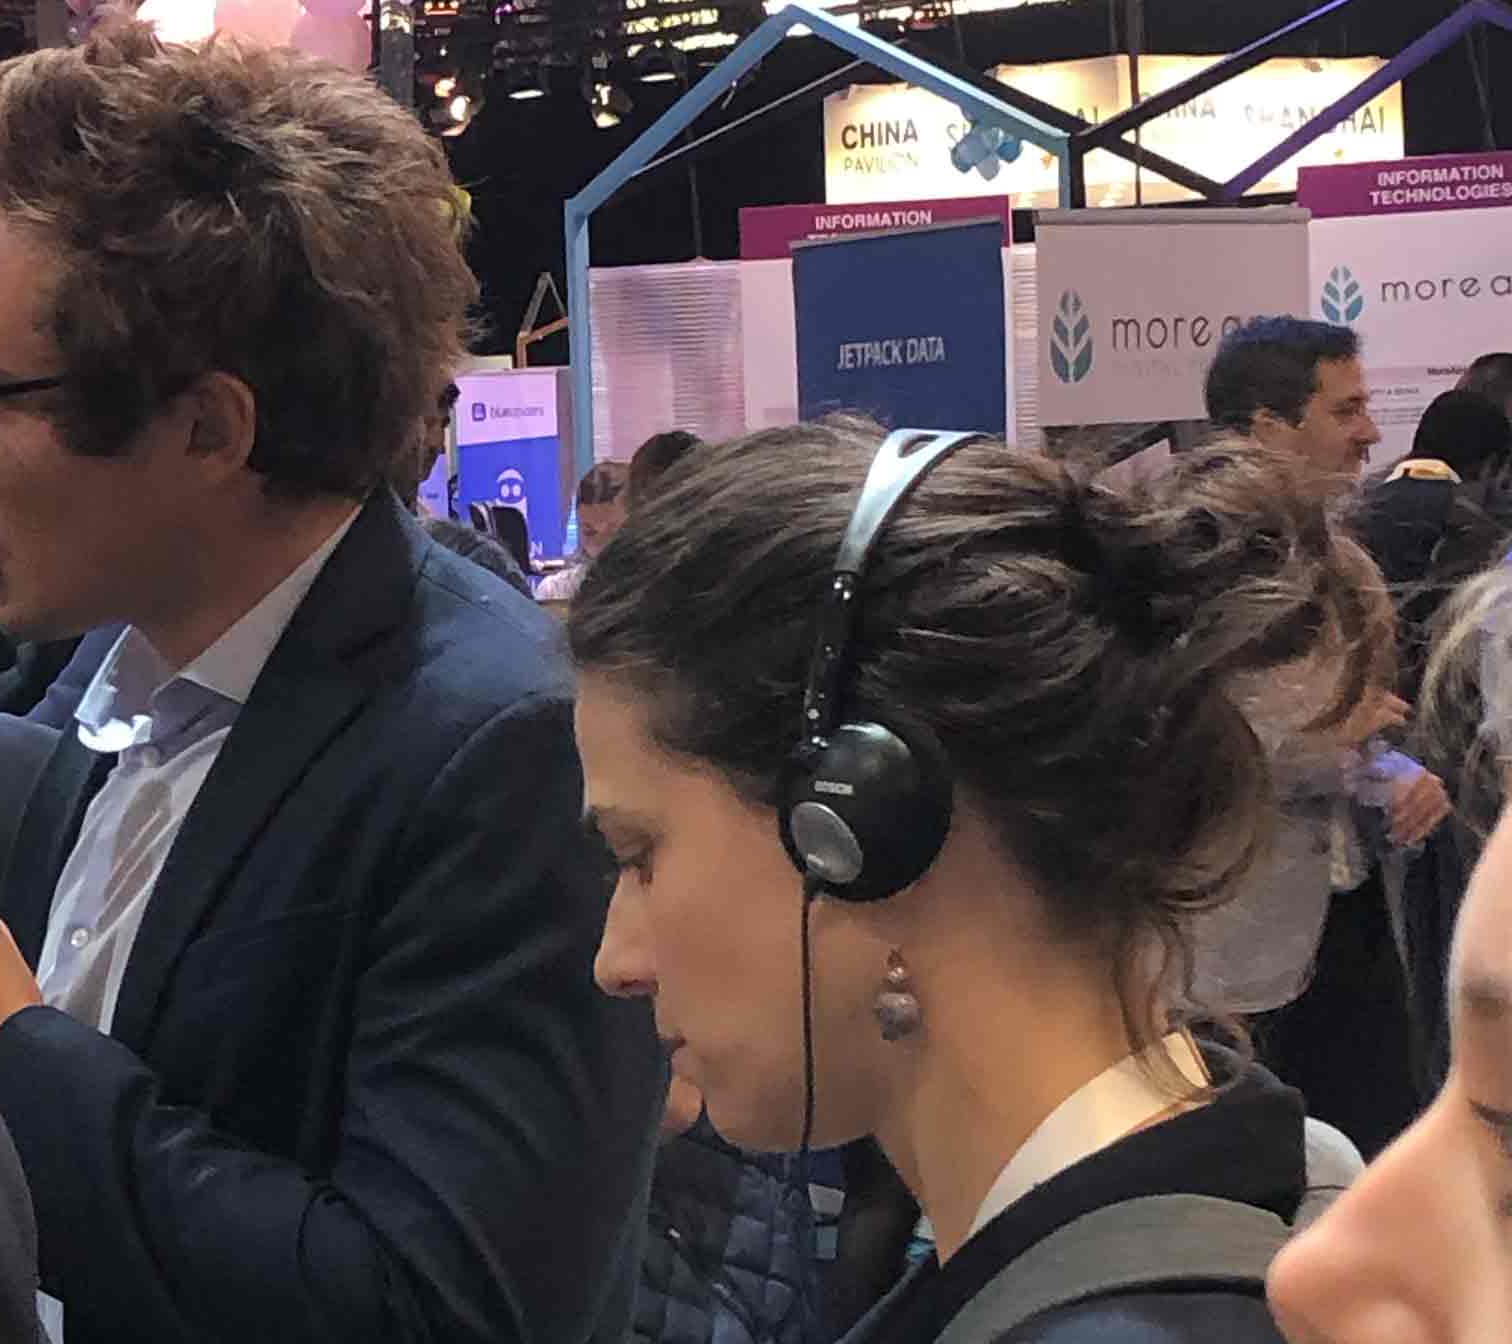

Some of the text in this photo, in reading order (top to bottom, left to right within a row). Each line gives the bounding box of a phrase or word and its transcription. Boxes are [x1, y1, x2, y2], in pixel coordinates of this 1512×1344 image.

[841, 118, 919, 150] CHINA
[1378, 164, 1504, 187] INFORMATION
[1369, 181, 1512, 207] TECHNOLOGIES
[815, 209, 933, 231] INFORMATION
[1381, 274, 1482, 302] more
[1111, 315, 1213, 350] more
[838, 335, 945, 370] JETPACK DATA
